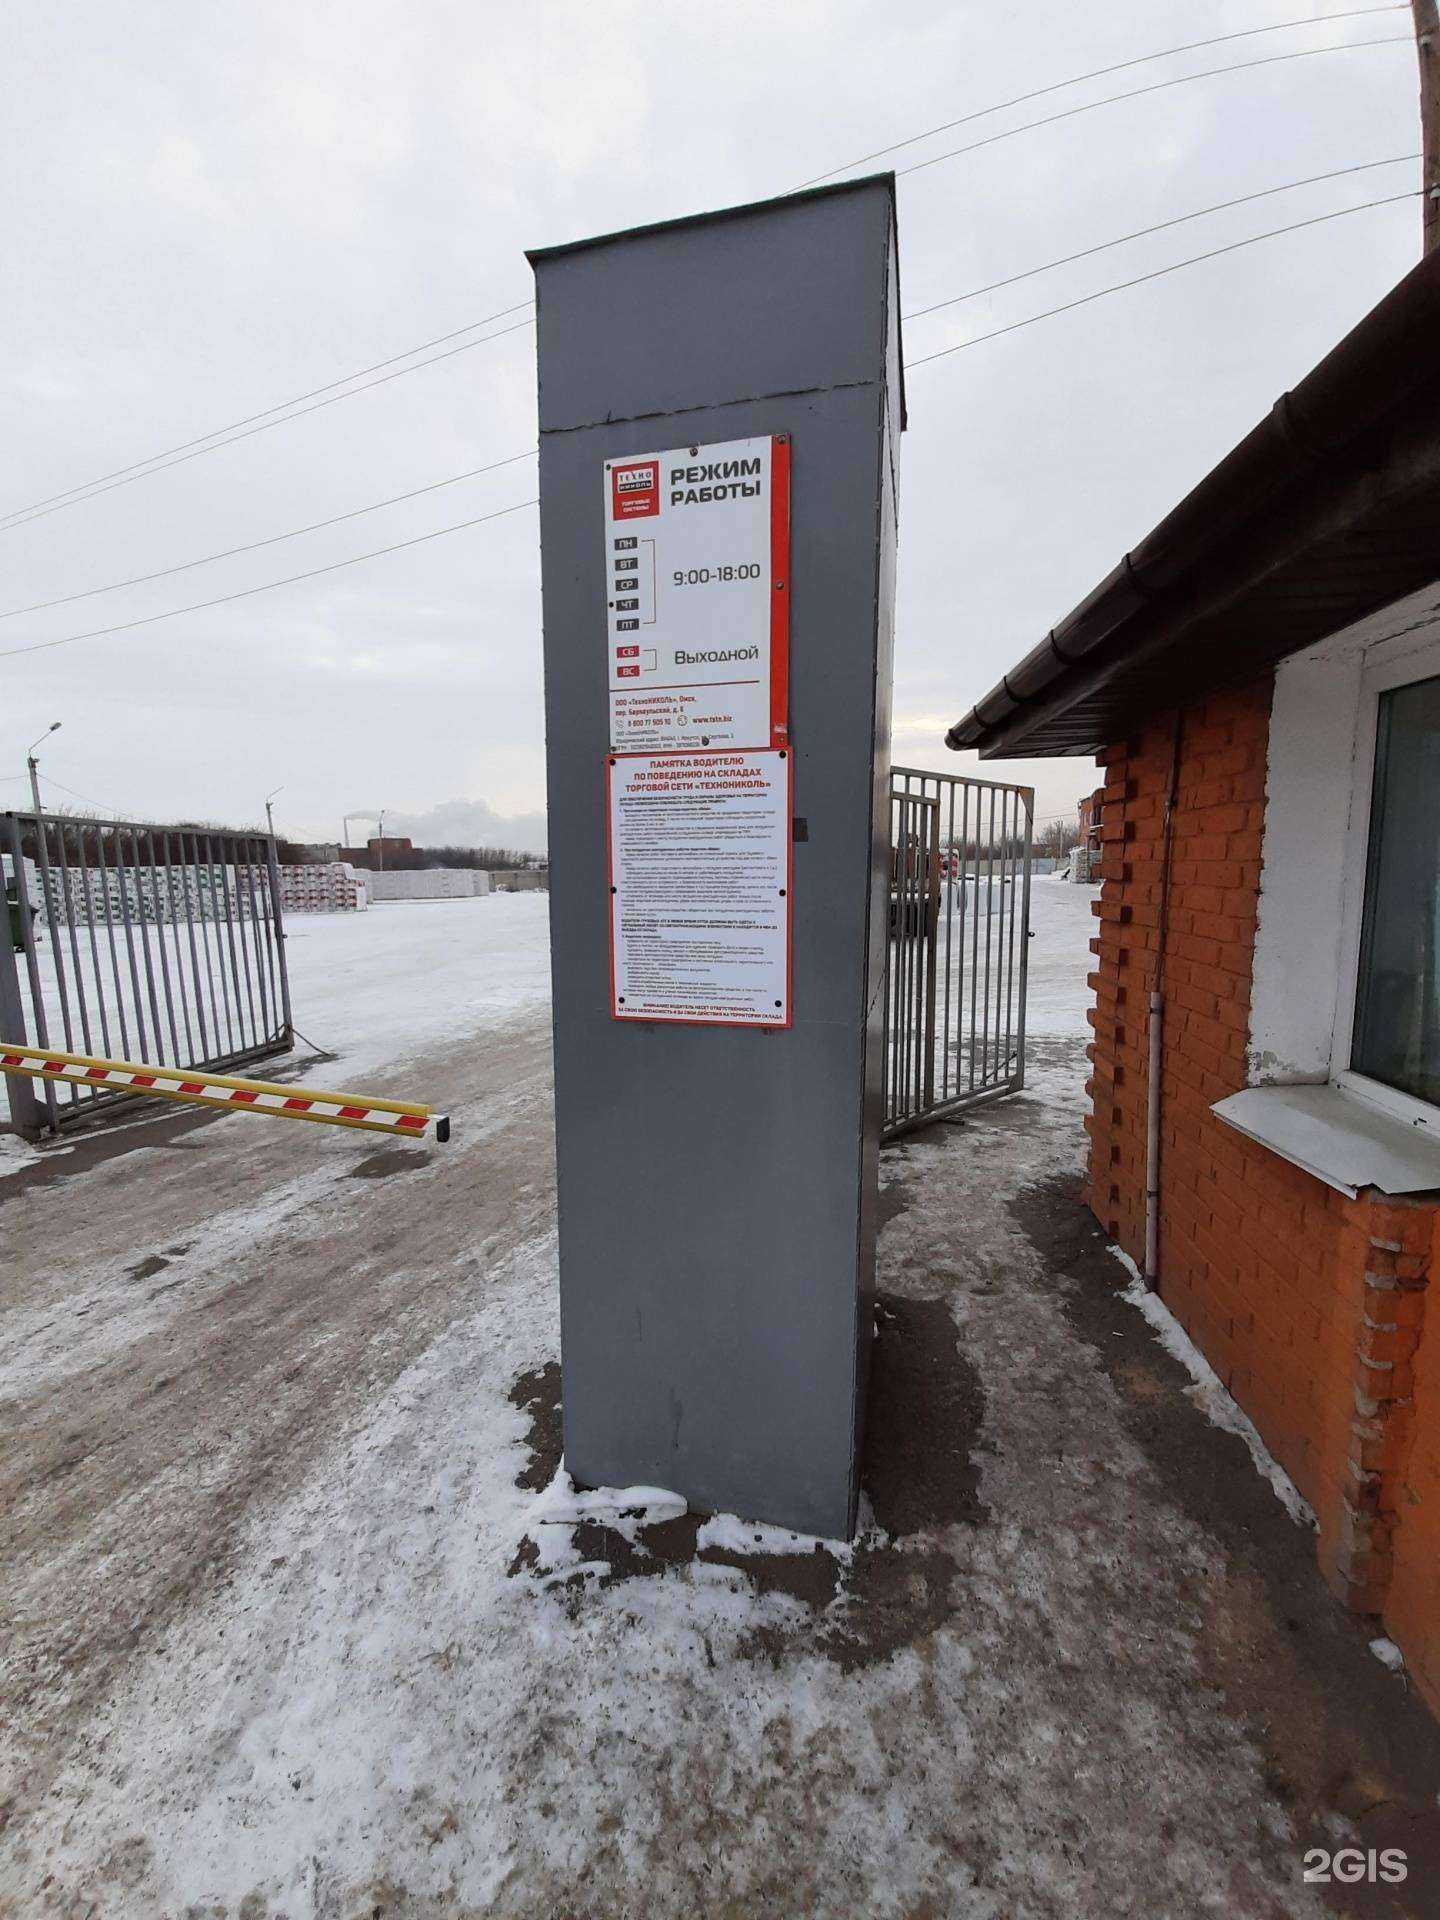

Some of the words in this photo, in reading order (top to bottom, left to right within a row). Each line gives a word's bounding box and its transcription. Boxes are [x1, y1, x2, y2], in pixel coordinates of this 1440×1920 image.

[619, 471, 652, 482] ТЕХНО
[670, 457, 761, 486] РЕЖИМ
[670, 480, 761, 506] РАБОТЫ
[618, 539, 634, 550] ПН
[619, 560, 634, 570] ВТ
[673, 563, 761, 586] 9:00-18:00
[620, 581, 634, 590] СР
[620, 600, 635, 610] ЧТ
[621, 620, 635, 630] ПТ
[622, 648, 636, 657] СБ
[674, 645, 759, 664] Выходной
[622, 668, 636, 677] ВС
[650, 759, 692, 768] ПАМЯТКА
[693, 757, 744, 767] ВОДИТЕЛЮ
[647, 770, 702, 780] ПОВЕДЕНИЮ
[703, 770, 716, 778] НА
[717, 768, 762, 778] СКЛАДАХ
[625, 782, 669, 792] ТОРГОВОЙ
[671, 782, 693, 791] СЕТИ
[694, 780, 771, 790] «ТЕХНОНИКОЛЬ»
